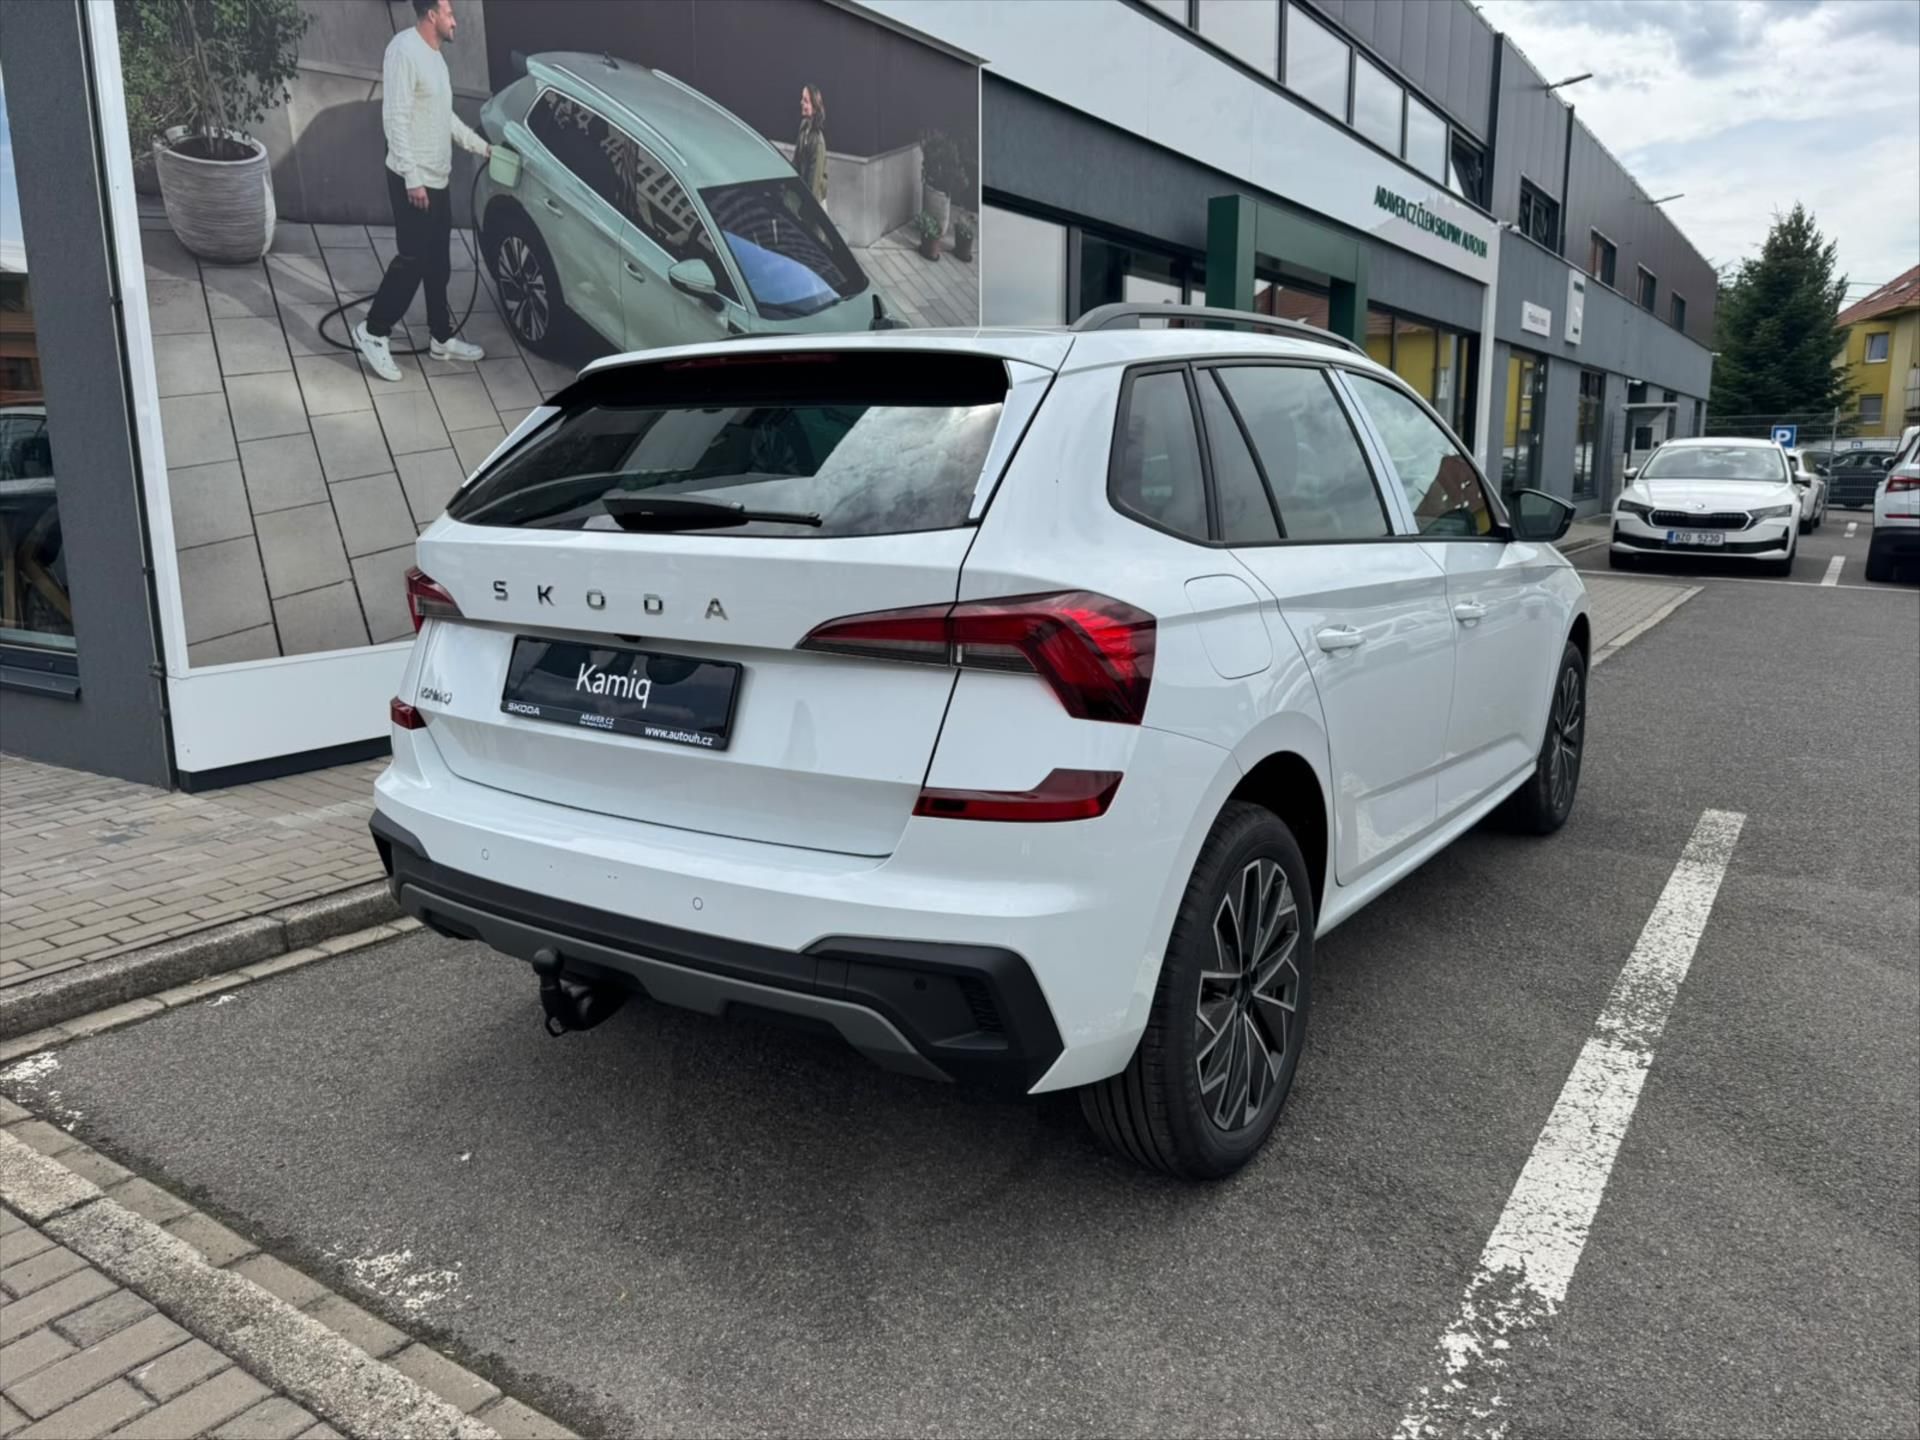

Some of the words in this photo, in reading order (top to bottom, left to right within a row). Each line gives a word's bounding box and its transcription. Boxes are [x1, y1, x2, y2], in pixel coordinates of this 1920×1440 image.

[1374, 185, 1406, 219] ARAVER
[1406, 202, 1417, 225] CZ
[1775, 429, 1791, 446] P
[576, 663, 651, 709] Kamiq
[644, 726, 714, 746] www.autouh.cz
